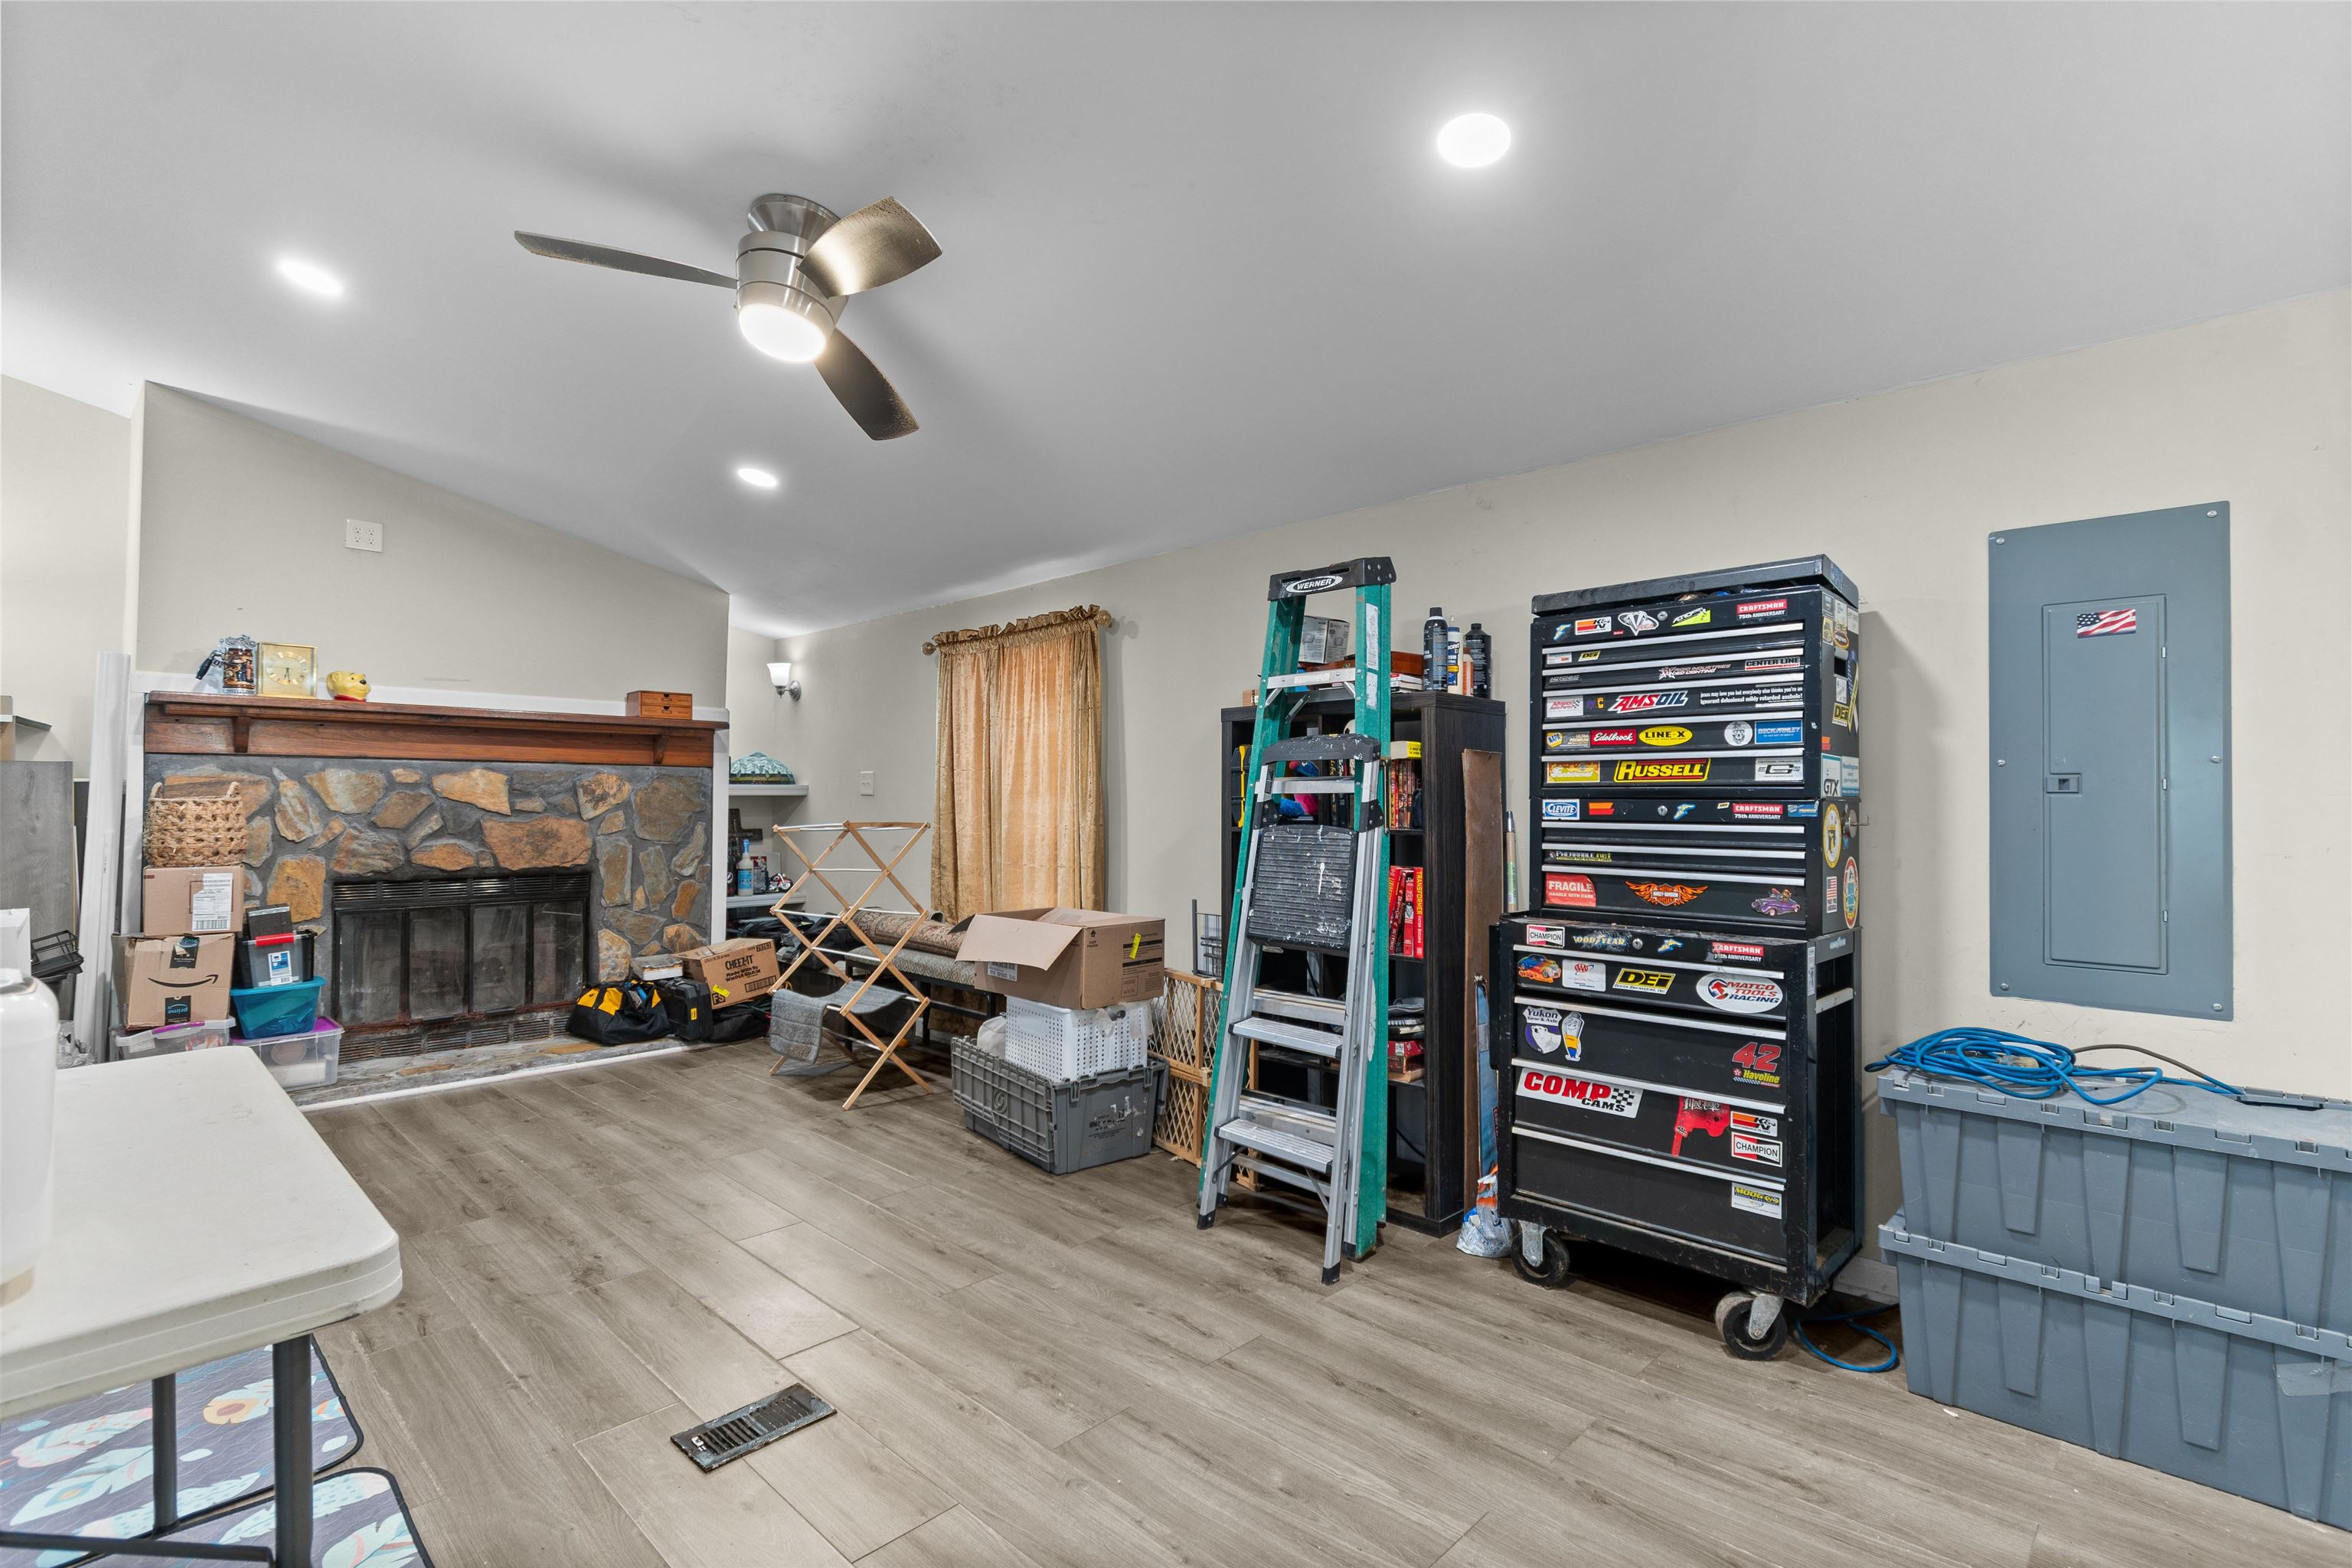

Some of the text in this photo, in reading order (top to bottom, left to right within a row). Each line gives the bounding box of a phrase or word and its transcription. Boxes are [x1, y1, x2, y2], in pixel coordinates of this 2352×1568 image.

[1297, 578, 1332, 590] WERNER
[1739, 603, 1785, 612] CRAFTSMAN
[1611, 691, 1688, 712] AMSOIL
[1593, 732, 1634, 743] Edelbrock
[1617, 760, 1704, 779] RUSSELL
[1824, 778, 1839, 796] GTX
[1547, 802, 1576, 814] CLEVITE
[1549, 880, 1593, 893] FRAGILE
[1530, 931, 1561, 940] CHAMPION
[724, 955, 753, 971] CHEEZ-IT
[1726, 981, 1775, 991] MATCO
[1735, 988, 1778, 997] TOOLS
[1729, 994, 1780, 1004] RACING
[168, 1005, 188, 1014] prime
[1527, 1008, 1558, 1018] Yukon
[1731, 1041, 1782, 1073] 42
[1743, 1070, 1781, 1083] Havoline
[1524, 1072, 1612, 1101] COMP
[1581, 1098, 1626, 1112] CAMS
[1736, 1142, 1779, 1157] CHAMPION
[1735, 1187, 1763, 1199] MOOG
